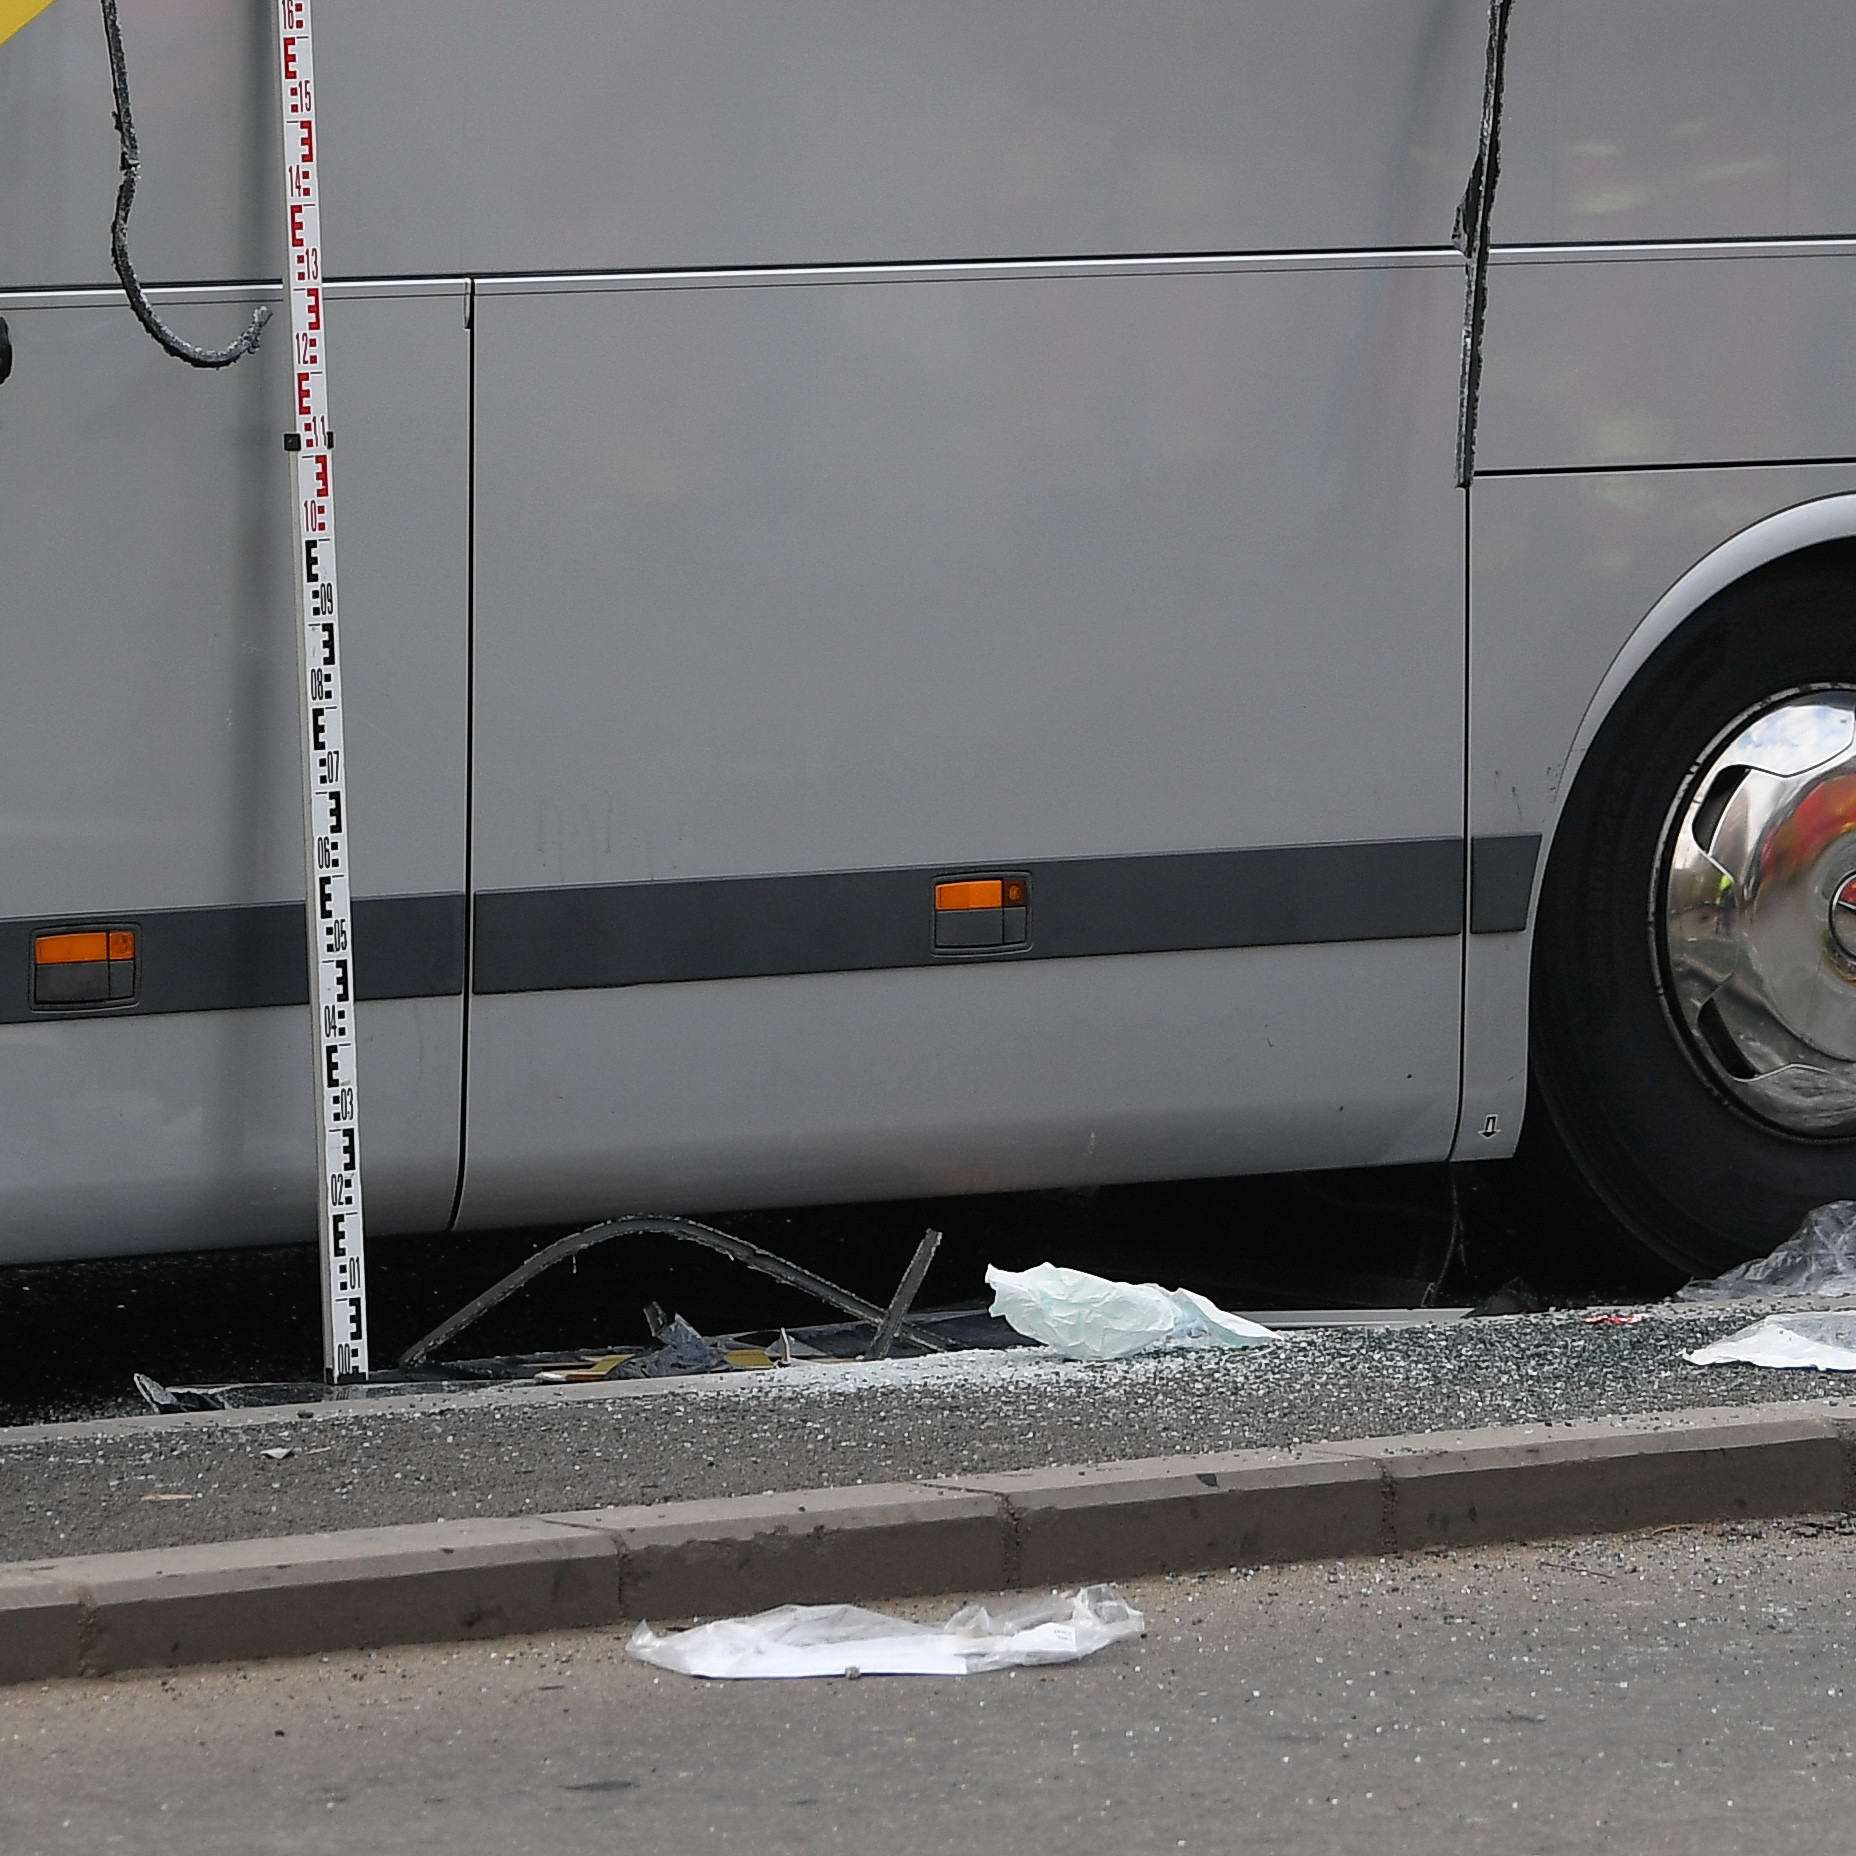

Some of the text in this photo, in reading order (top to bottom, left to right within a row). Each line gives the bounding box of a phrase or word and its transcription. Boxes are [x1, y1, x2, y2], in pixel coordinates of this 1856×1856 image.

[298, 79, 312, 113] 15
[289, 165, 302, 197] 14
[305, 247, 318, 280] 13
[296, 332, 309, 365] 12
[312, 415, 327, 447] 11
[304, 499, 317, 532] 10
[320, 582, 334, 615] 09
[310, 668, 324, 701] 08
[327, 750, 340, 783] 07
[317, 836, 330, 869] 06
[334, 918, 348, 952] 05
[324, 1004, 337, 1038] 04
[340, 1087, 354, 1121] 03
[330, 1173, 344, 1206] 02
[349, 1255, 361, 1289] 01
[337, 1343, 350, 1374] 00
